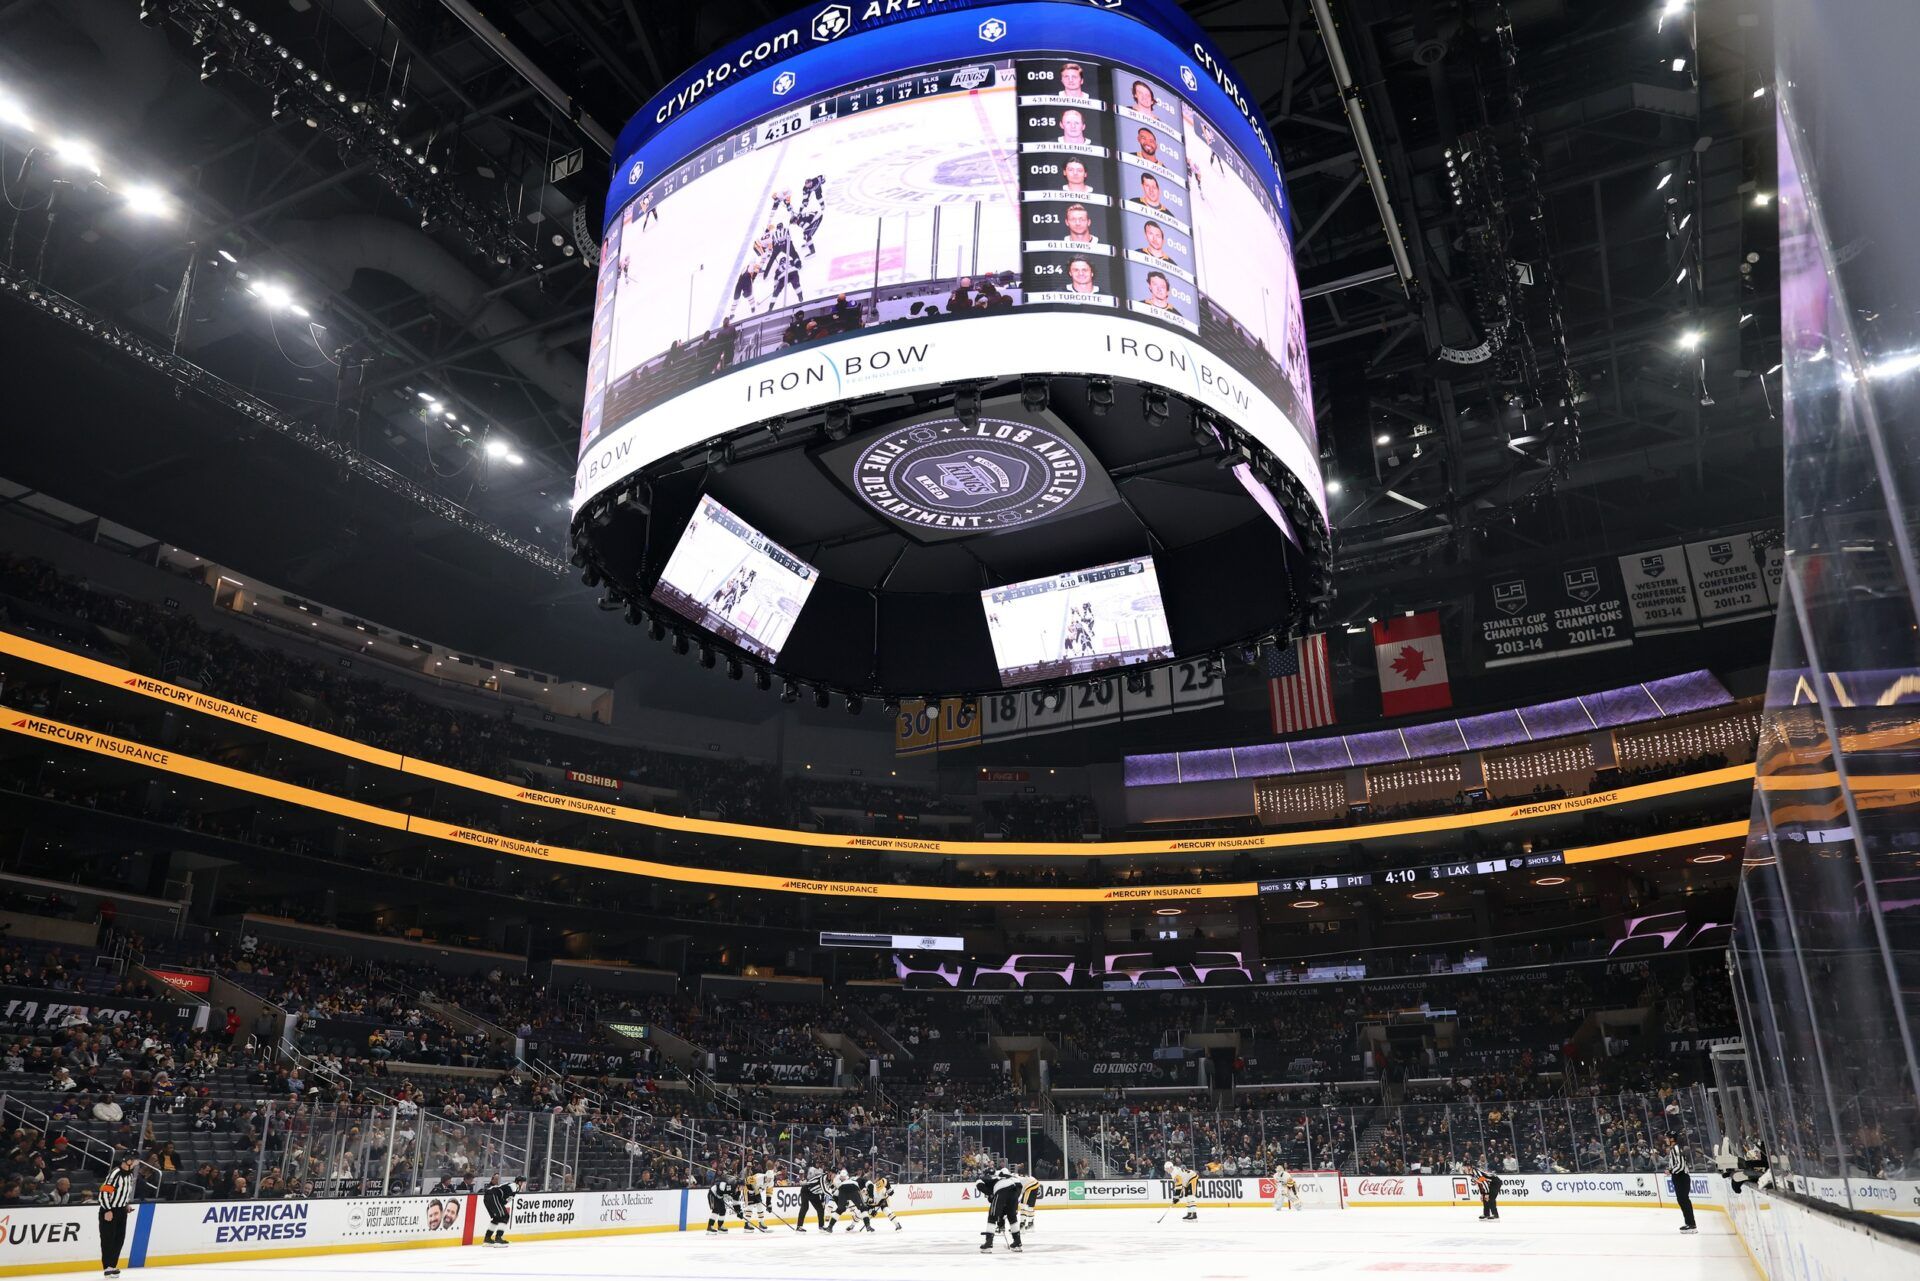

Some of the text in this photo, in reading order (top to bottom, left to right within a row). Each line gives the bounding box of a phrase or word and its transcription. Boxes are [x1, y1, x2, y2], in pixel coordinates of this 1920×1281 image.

[655, 0, 944, 125] crypto.com AR
[956, 72, 985, 83] KINGS
[1027, 71, 1054, 80] 0:08
[898, 88, 912, 100] 17
[924, 84, 938, 94] 13
[876, 95, 884, 104] 3
[1194, 43, 1274, 164] crypto.com
[818, 102, 828, 116] 1
[852, 102, 859, 111] 2
[1029, 118, 1056, 127] 0:35
[765, 118, 802, 141] 4:10
[741, 132, 750, 147] 5
[700, 165, 704, 174] 1
[1030, 165, 1058, 174] 0:08
[664, 184, 674, 196] 12
[1059, 192, 1091, 200] SPENCE
[1032, 214, 1060, 224] 0:31
[1034, 265, 1063, 274] 0:34
[747, 344, 928, 402] IRON BOW
[1106, 335, 1186, 371] IRON
[1201, 364, 1249, 410] BOW
[590, 438, 632, 478] BOW
[977, 422, 1078, 504] LOS ANGELES
[862, 441, 982, 527] FIRE DEPARTMENT
[946, 466, 990, 492] KINGS
[919, 477, 944, 498] LAFD
[750, 538, 763, 550] 4:10
[1709, 544, 1731, 554] LA
[1642, 556, 1663, 568] LA
[1567, 570, 1596, 585] LA
[1703, 565, 1748, 578] WESTERN
[1060, 580, 1076, 588] 4:10
[1636, 578, 1679, 590] WESTERN
[1699, 572, 1758, 590] CONFERENCE
[1496, 584, 1524, 598] LA
[1631, 586, 1687, 601] CONFERENCE
[1704, 582, 1757, 598] CHAMPIONS
[1636, 596, 1687, 609] CHAMPIONS
[1714, 594, 1752, 610] 2011-12
[1554, 600, 1620, 619] STANLEY CUP
[1644, 608, 1683, 620] 2013-14
[1482, 613, 1547, 630] STANLEY CUP
[1556, 610, 1623, 630] CHAMPIONS
[1484, 622, 1550, 641] CHAMPIONS
[1568, 625, 1616, 644] 2011-12
[1494, 638, 1544, 655] 2013-14
[1180, 661, 1213, 692] 23
[138, 678, 258, 724] MERCURY INSURANCE
[1078, 681, 1113, 708] 20
[990, 694, 1016, 723] 18
[901, 711, 931, 738] 30
[28, 719, 169, 765] MERCURY INSURANCE
[572, 771, 618, 788] TOSHIBA
[525, 792, 616, 816] MERCURY INSURANCE
[1519, 792, 1618, 816] MERCURY INSURANCE
[459, 830, 549, 856] MERCURY INSURANCE
[855, 838, 940, 850] MERCURY INSURANCE
[1178, 838, 1266, 850] MERCURY INSURANCE
[1528, 854, 1562, 865] SHOTS 24
[1448, 864, 1470, 876] LAK
[1488, 862, 1496, 872] 1
[1347, 876, 1364, 886] PIT
[1385, 869, 1416, 884] 4:10
[1433, 870, 1440, 879] 3
[790, 881, 878, 894] MERCURY INSURANCE
[1260, 882, 1292, 892] SHOTS 32
[1320, 879, 1328, 889] 5
[1112, 888, 1202, 898] MERCURY INSURANCE
[177, 1008, 190, 1018] 111
[306, 1019, 316, 1028] 12
[1093, 1063, 1107, 1074] GO
[1108, 1063, 1138, 1074] KINGS
[1072, 1184, 1146, 1197] enterprise
[1197, 1179, 1243, 1199] CLASSIC
[1511, 1188, 1529, 1197] app
[1556, 1180, 1624, 1193] crypto.com
[516, 1198, 574, 1210] Save money
[601, 1193, 654, 1206] Keck Medicine
[776, 1189, 802, 1212] Spe
[202, 1203, 308, 1224] AMERICAN
[368, 1206, 402, 1217] GOT HURT?
[515, 1211, 575, 1224] with the app
[600, 1208, 628, 1222] of USC
[366, 1216, 420, 1228] VISIT JUSTICE.LA!
[216, 1222, 307, 1243] EXPRESS
